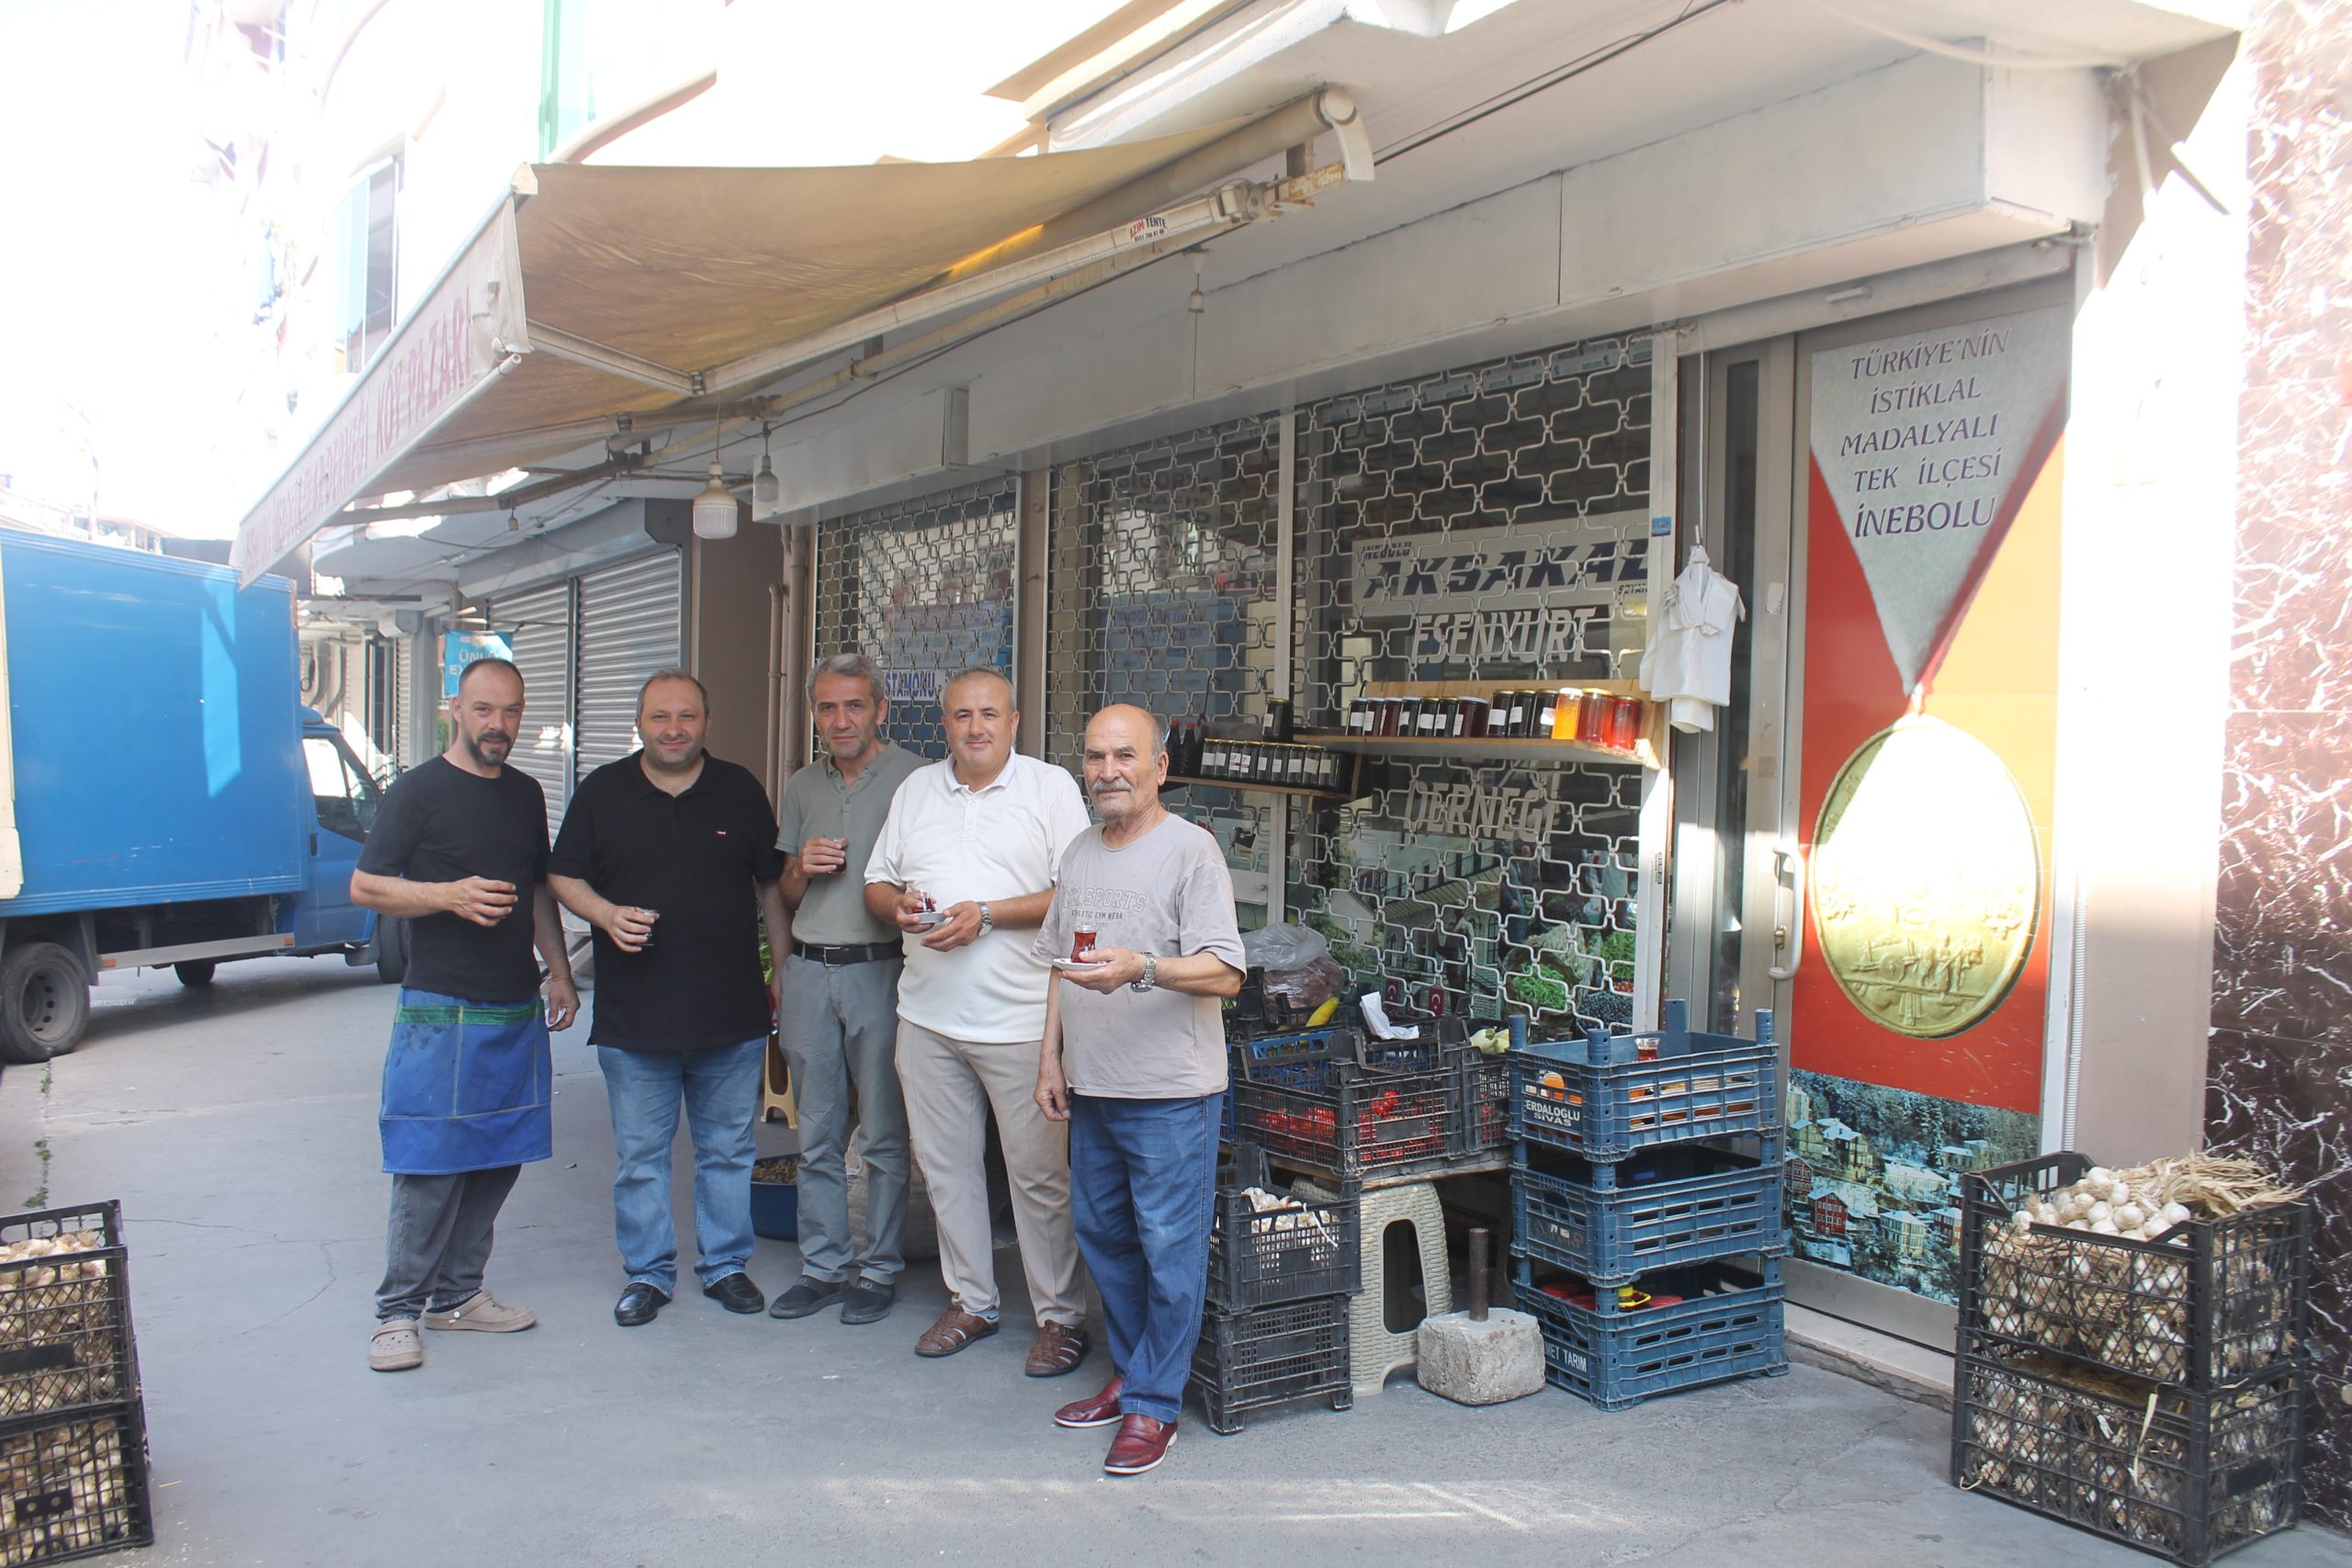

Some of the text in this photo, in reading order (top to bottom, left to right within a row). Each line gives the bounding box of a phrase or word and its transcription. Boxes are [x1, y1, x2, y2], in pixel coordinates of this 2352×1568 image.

[408, 286, 471, 429] PAZARI
[1851, 326, 2010, 379] TÜRKİYE'NİN
[1870, 376, 1983, 414] İSTİKLAL
[1840, 413, 1998, 457] MADALYALI
[1854, 447, 2002, 492] TEK İLÇESİ
[1854, 497, 1996, 537] İNEBOLU
[1411, 606, 1597, 663] ESENYURT
[885, 672, 935, 698] STAMONU
[1083, 887, 1148, 913] SPORTS
[1094, 911, 1106, 919] GYM
[1544, 1341, 1588, 1373] MET TARIM
